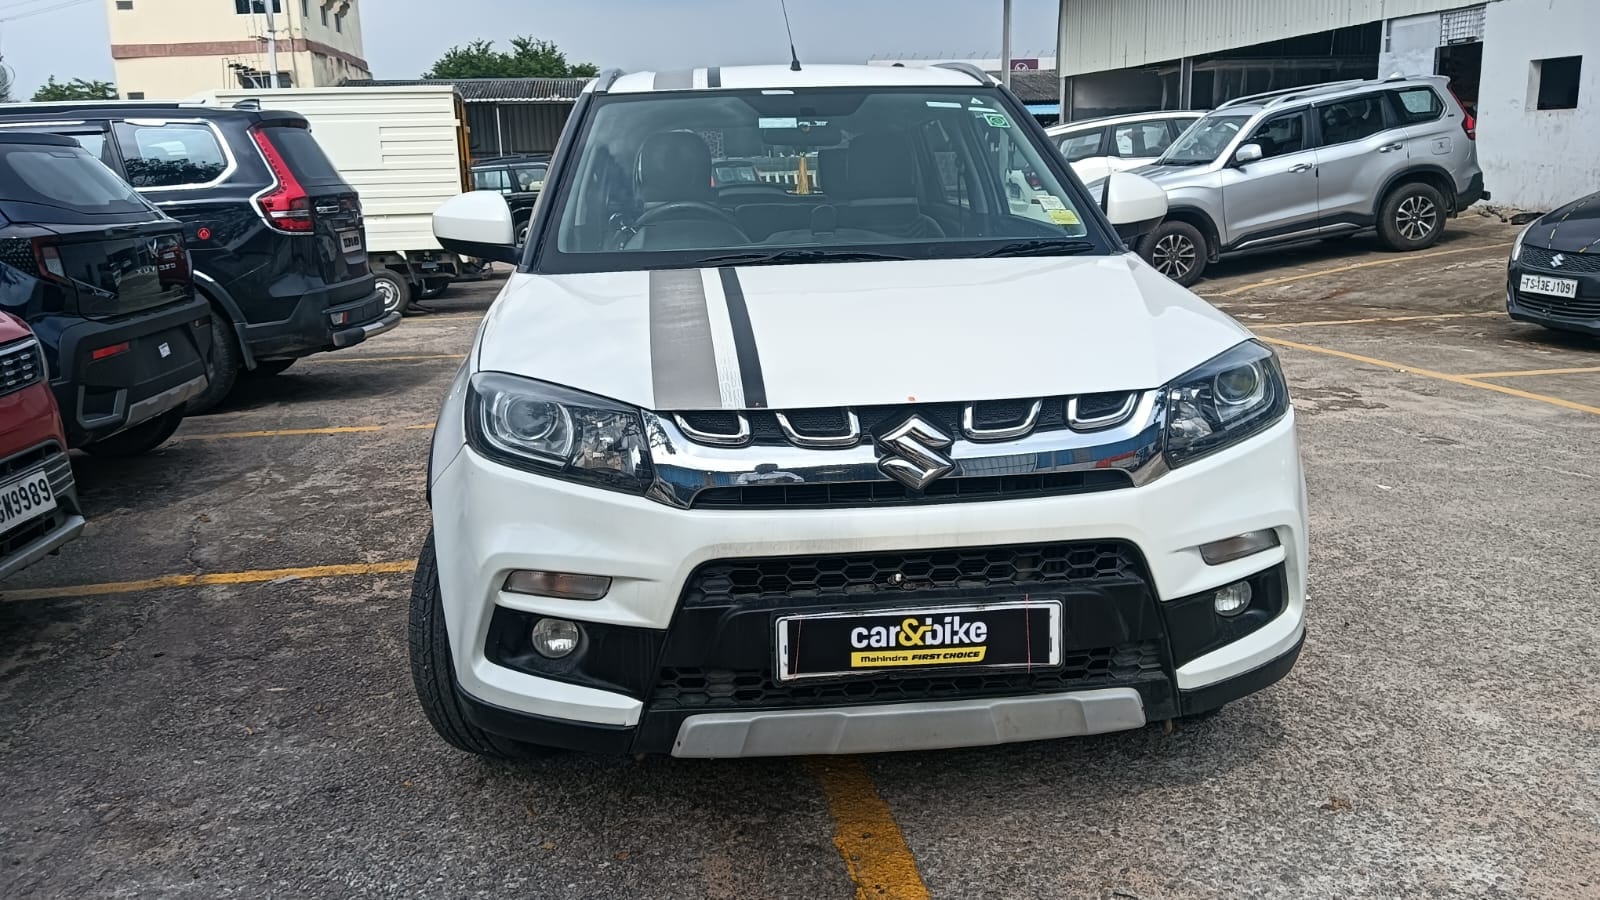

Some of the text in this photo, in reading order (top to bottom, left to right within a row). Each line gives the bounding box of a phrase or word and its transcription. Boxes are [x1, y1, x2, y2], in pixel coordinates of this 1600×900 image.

[851, 616, 987, 648] car&bike
[860, 651, 980, 663] Mahindra FIRST CHOICE
